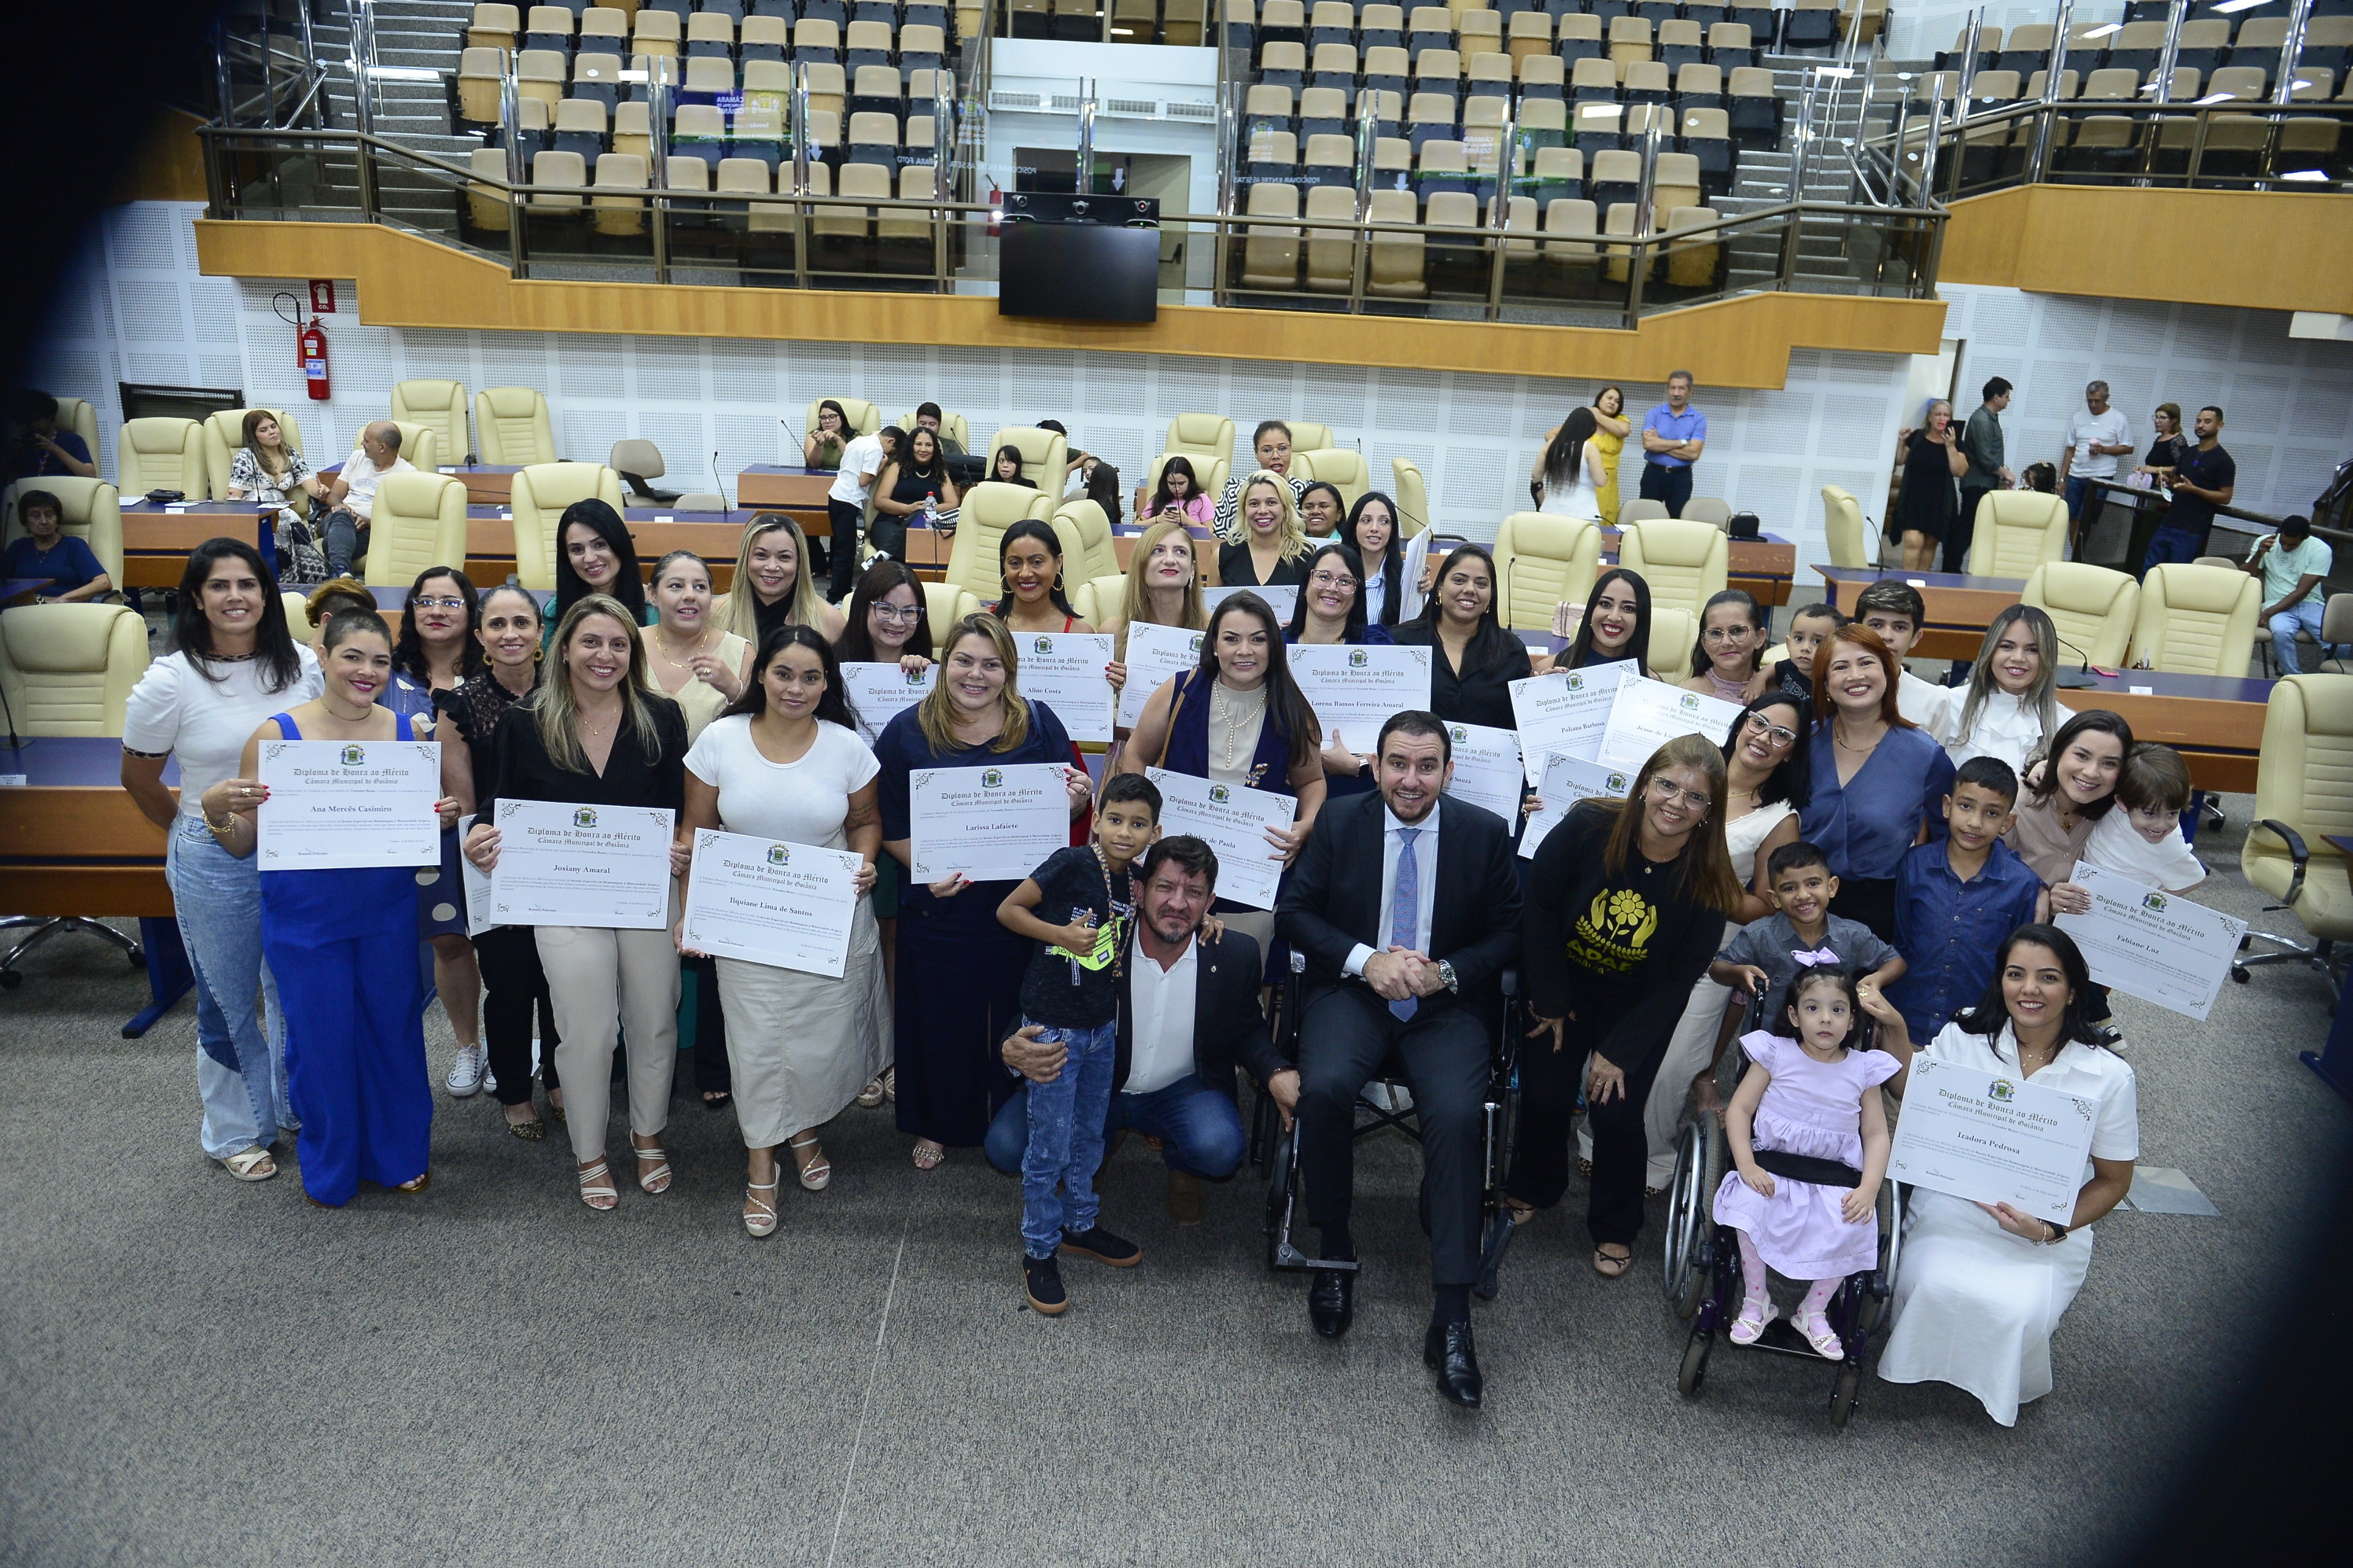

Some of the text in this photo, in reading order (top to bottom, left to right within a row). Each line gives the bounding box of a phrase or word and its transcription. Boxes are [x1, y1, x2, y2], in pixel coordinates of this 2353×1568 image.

[1152, 648, 1179, 659] Diploma
[1350, 669, 1371, 677] Honra
[1535, 697, 1561, 707] Diploma
[1569, 693, 1589, 701] Honra
[1590, 691, 1598, 699] ao
[293, 768, 329, 777] Diploma
[342, 768, 368, 776] Honra
[381, 768, 409, 776] Mérito
[1566, 779, 1594, 794] Diploma
[1169, 796, 1197, 808] Diploma
[1198, 802, 1207, 813] de
[1207, 803, 1230, 815] Honra
[1240, 811, 1265, 822] Mérito
[1176, 806, 1198, 815] Câmara
[1198, 810, 1225, 821] Municipal
[1232, 818, 1254, 827] Goiânia
[527, 827, 561, 836] Diploma
[574, 829, 600, 838] Honra
[613, 832, 641, 841] Mérito
[563, 838, 596, 847] Municipal
[1218, 839, 1236, 849] Paula
[553, 864, 582, 874] Josiany
[723, 859, 755, 872] Diploma
[766, 866, 791, 877] Honra
[802, 873, 828, 884] Mérito
[732, 871, 755, 880] Câmara
[756, 874, 786, 885] Municipal
[794, 881, 817, 890] Goiânia
[730, 897, 758, 908] Ilquiane
[760, 902, 777, 911] Lima
[789, 907, 812, 917] Santos
[2095, 894, 2128, 911] Diploma
[2129, 906, 2138, 917] de
[2139, 909, 2165, 924] Honra
[2176, 924, 2205, 938] Mérito
[2103, 906, 2127, 917] Câmara
[2127, 914, 2159, 929] Municipal
[2166, 928, 2191, 941] Goiânia
[2117, 934, 2159, 954] Fabiane Luz
[1939, 1088, 1973, 1104] Diploma
[1975, 1098, 1985, 1108] de
[1986, 1101, 2014, 1115] Honra
[2027, 1113, 2058, 1126] Mérito
[1947, 1101, 1973, 1113] Câmara
[1974, 1108, 2008, 1122] Municipal
[2017, 1120, 2044, 1132] Goiânia
[1957, 1131, 2020, 1154] Izadora Pedrosa
